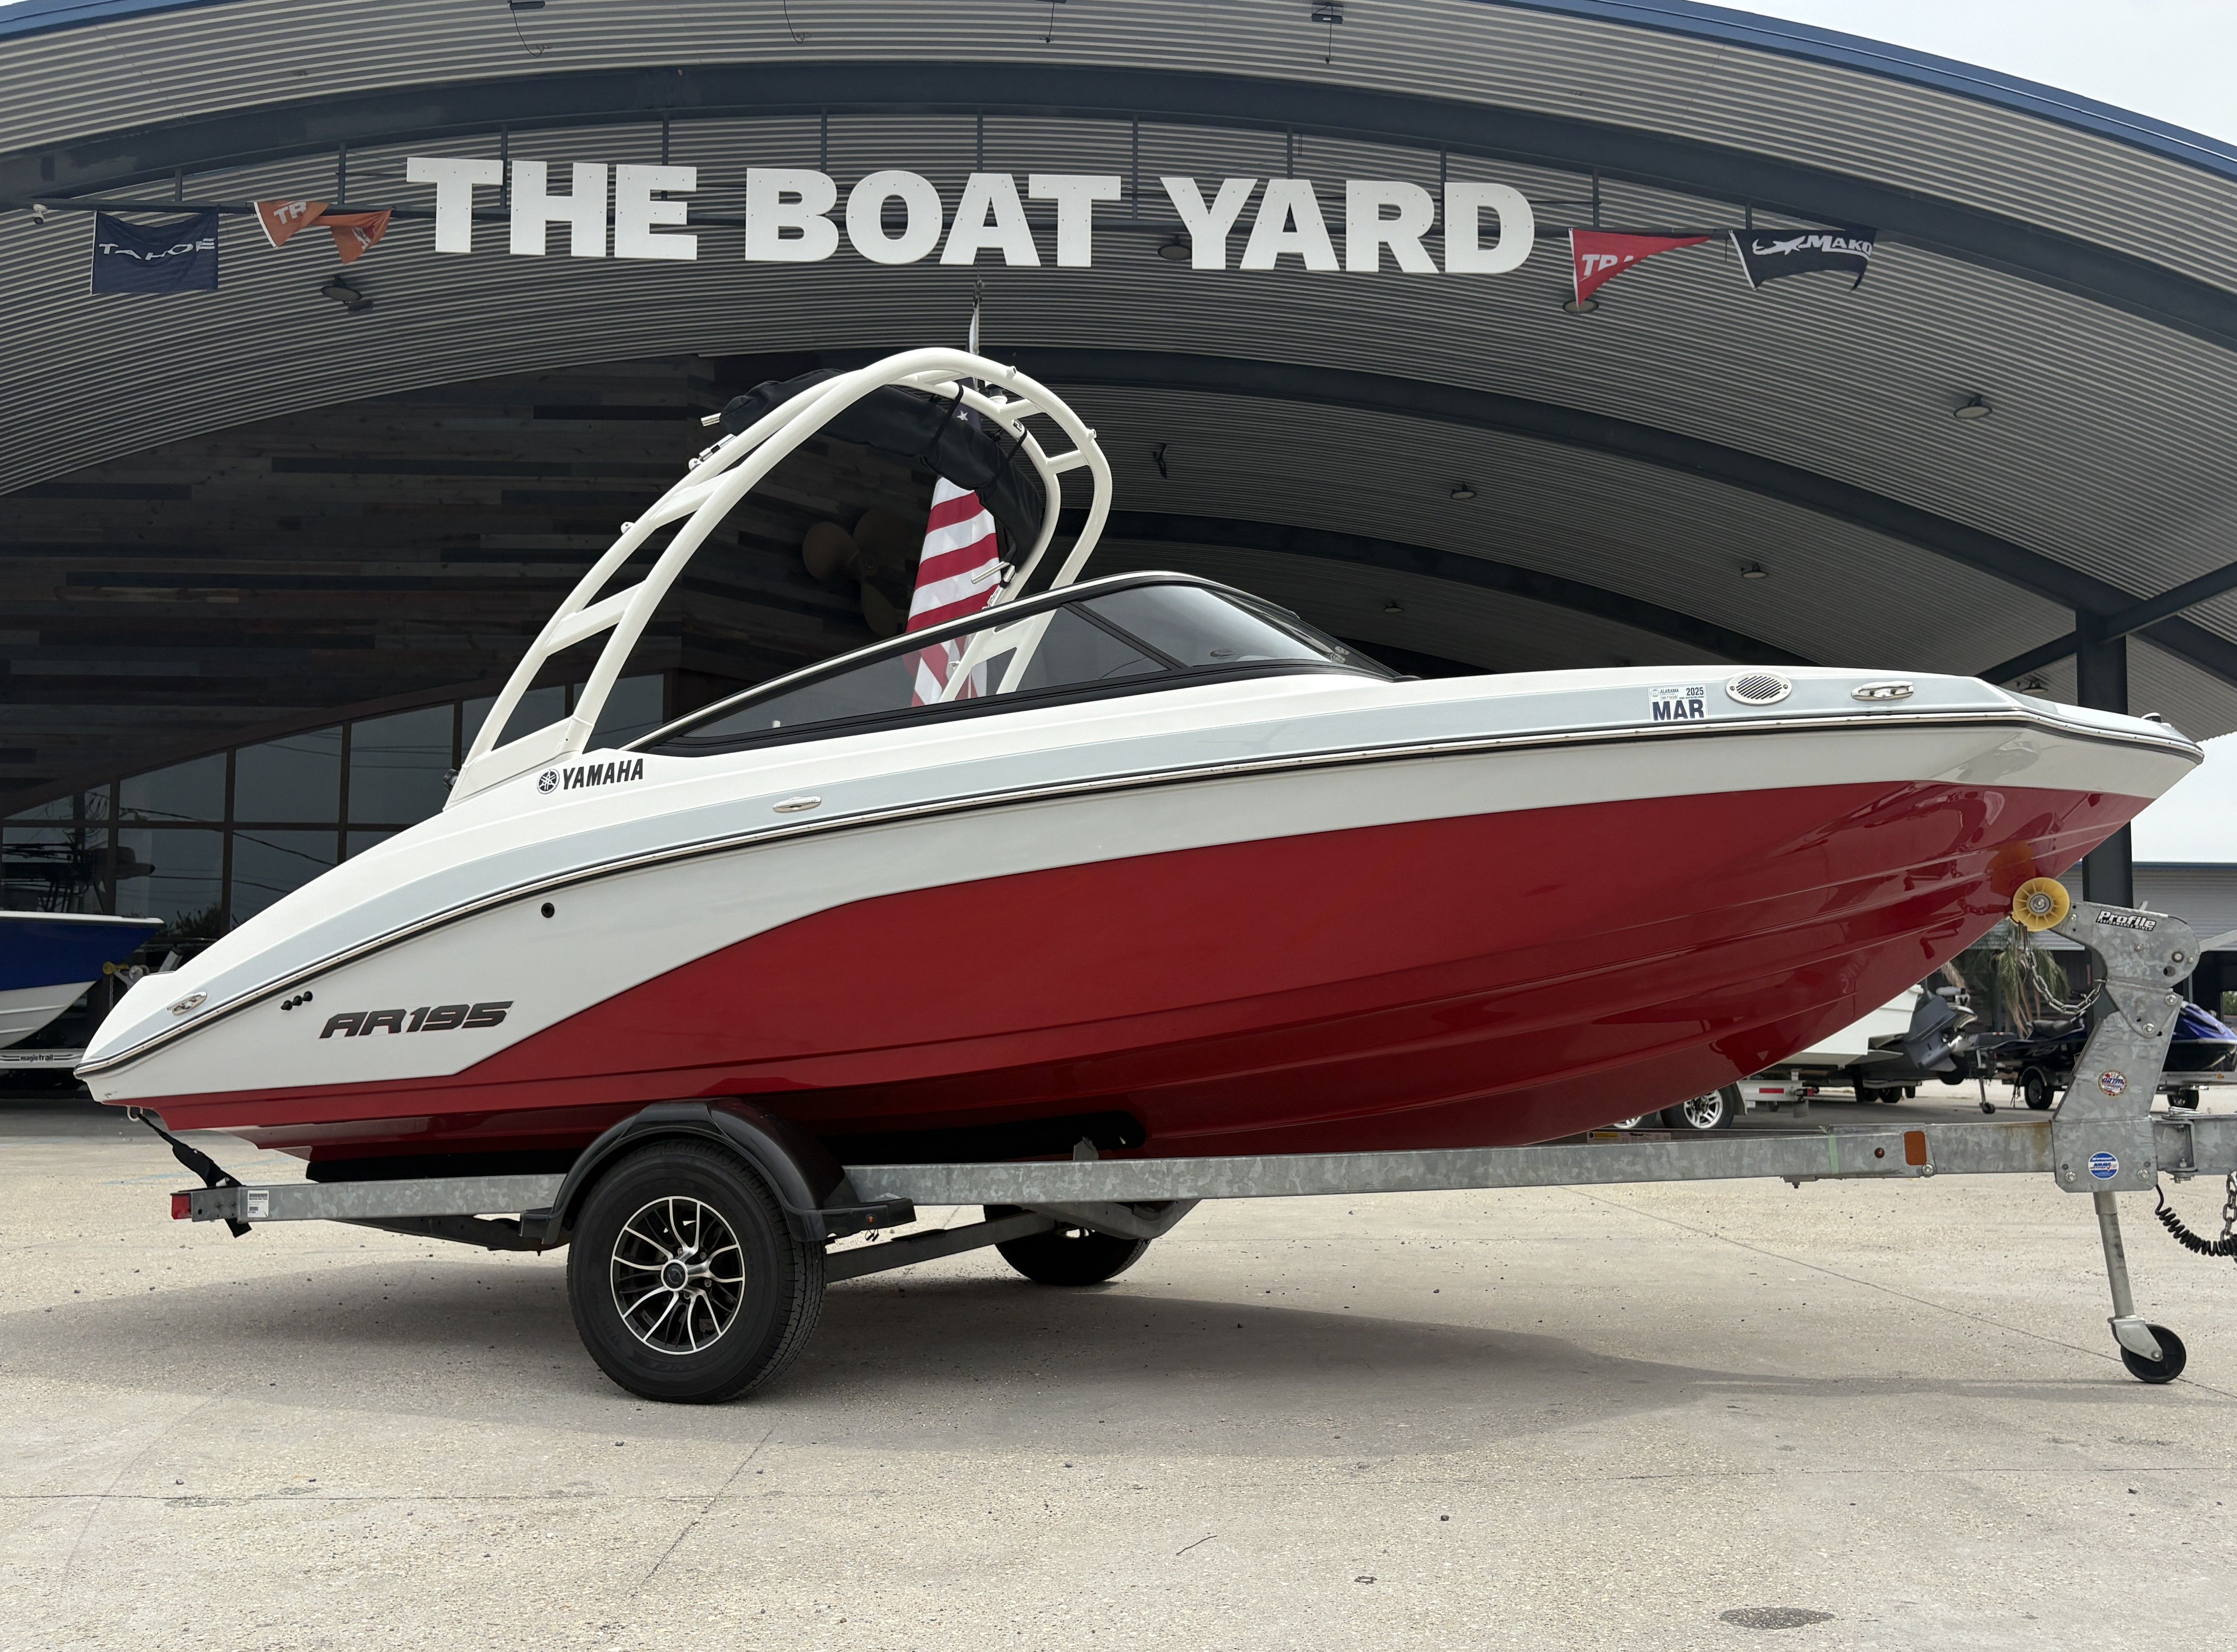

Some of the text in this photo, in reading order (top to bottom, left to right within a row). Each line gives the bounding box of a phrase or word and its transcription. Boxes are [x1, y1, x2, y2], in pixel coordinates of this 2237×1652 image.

[407, 157, 1535, 273] THE BOAT YARD
[1799, 234, 1872, 257] MAKO
[1686, 687, 1704, 696] 2025
[1652, 699, 1705, 721] MAR
[563, 758, 643, 790] YAMAHA
[2098, 910, 2156, 927] Profile
[319, 1001, 514, 1039] AR195
